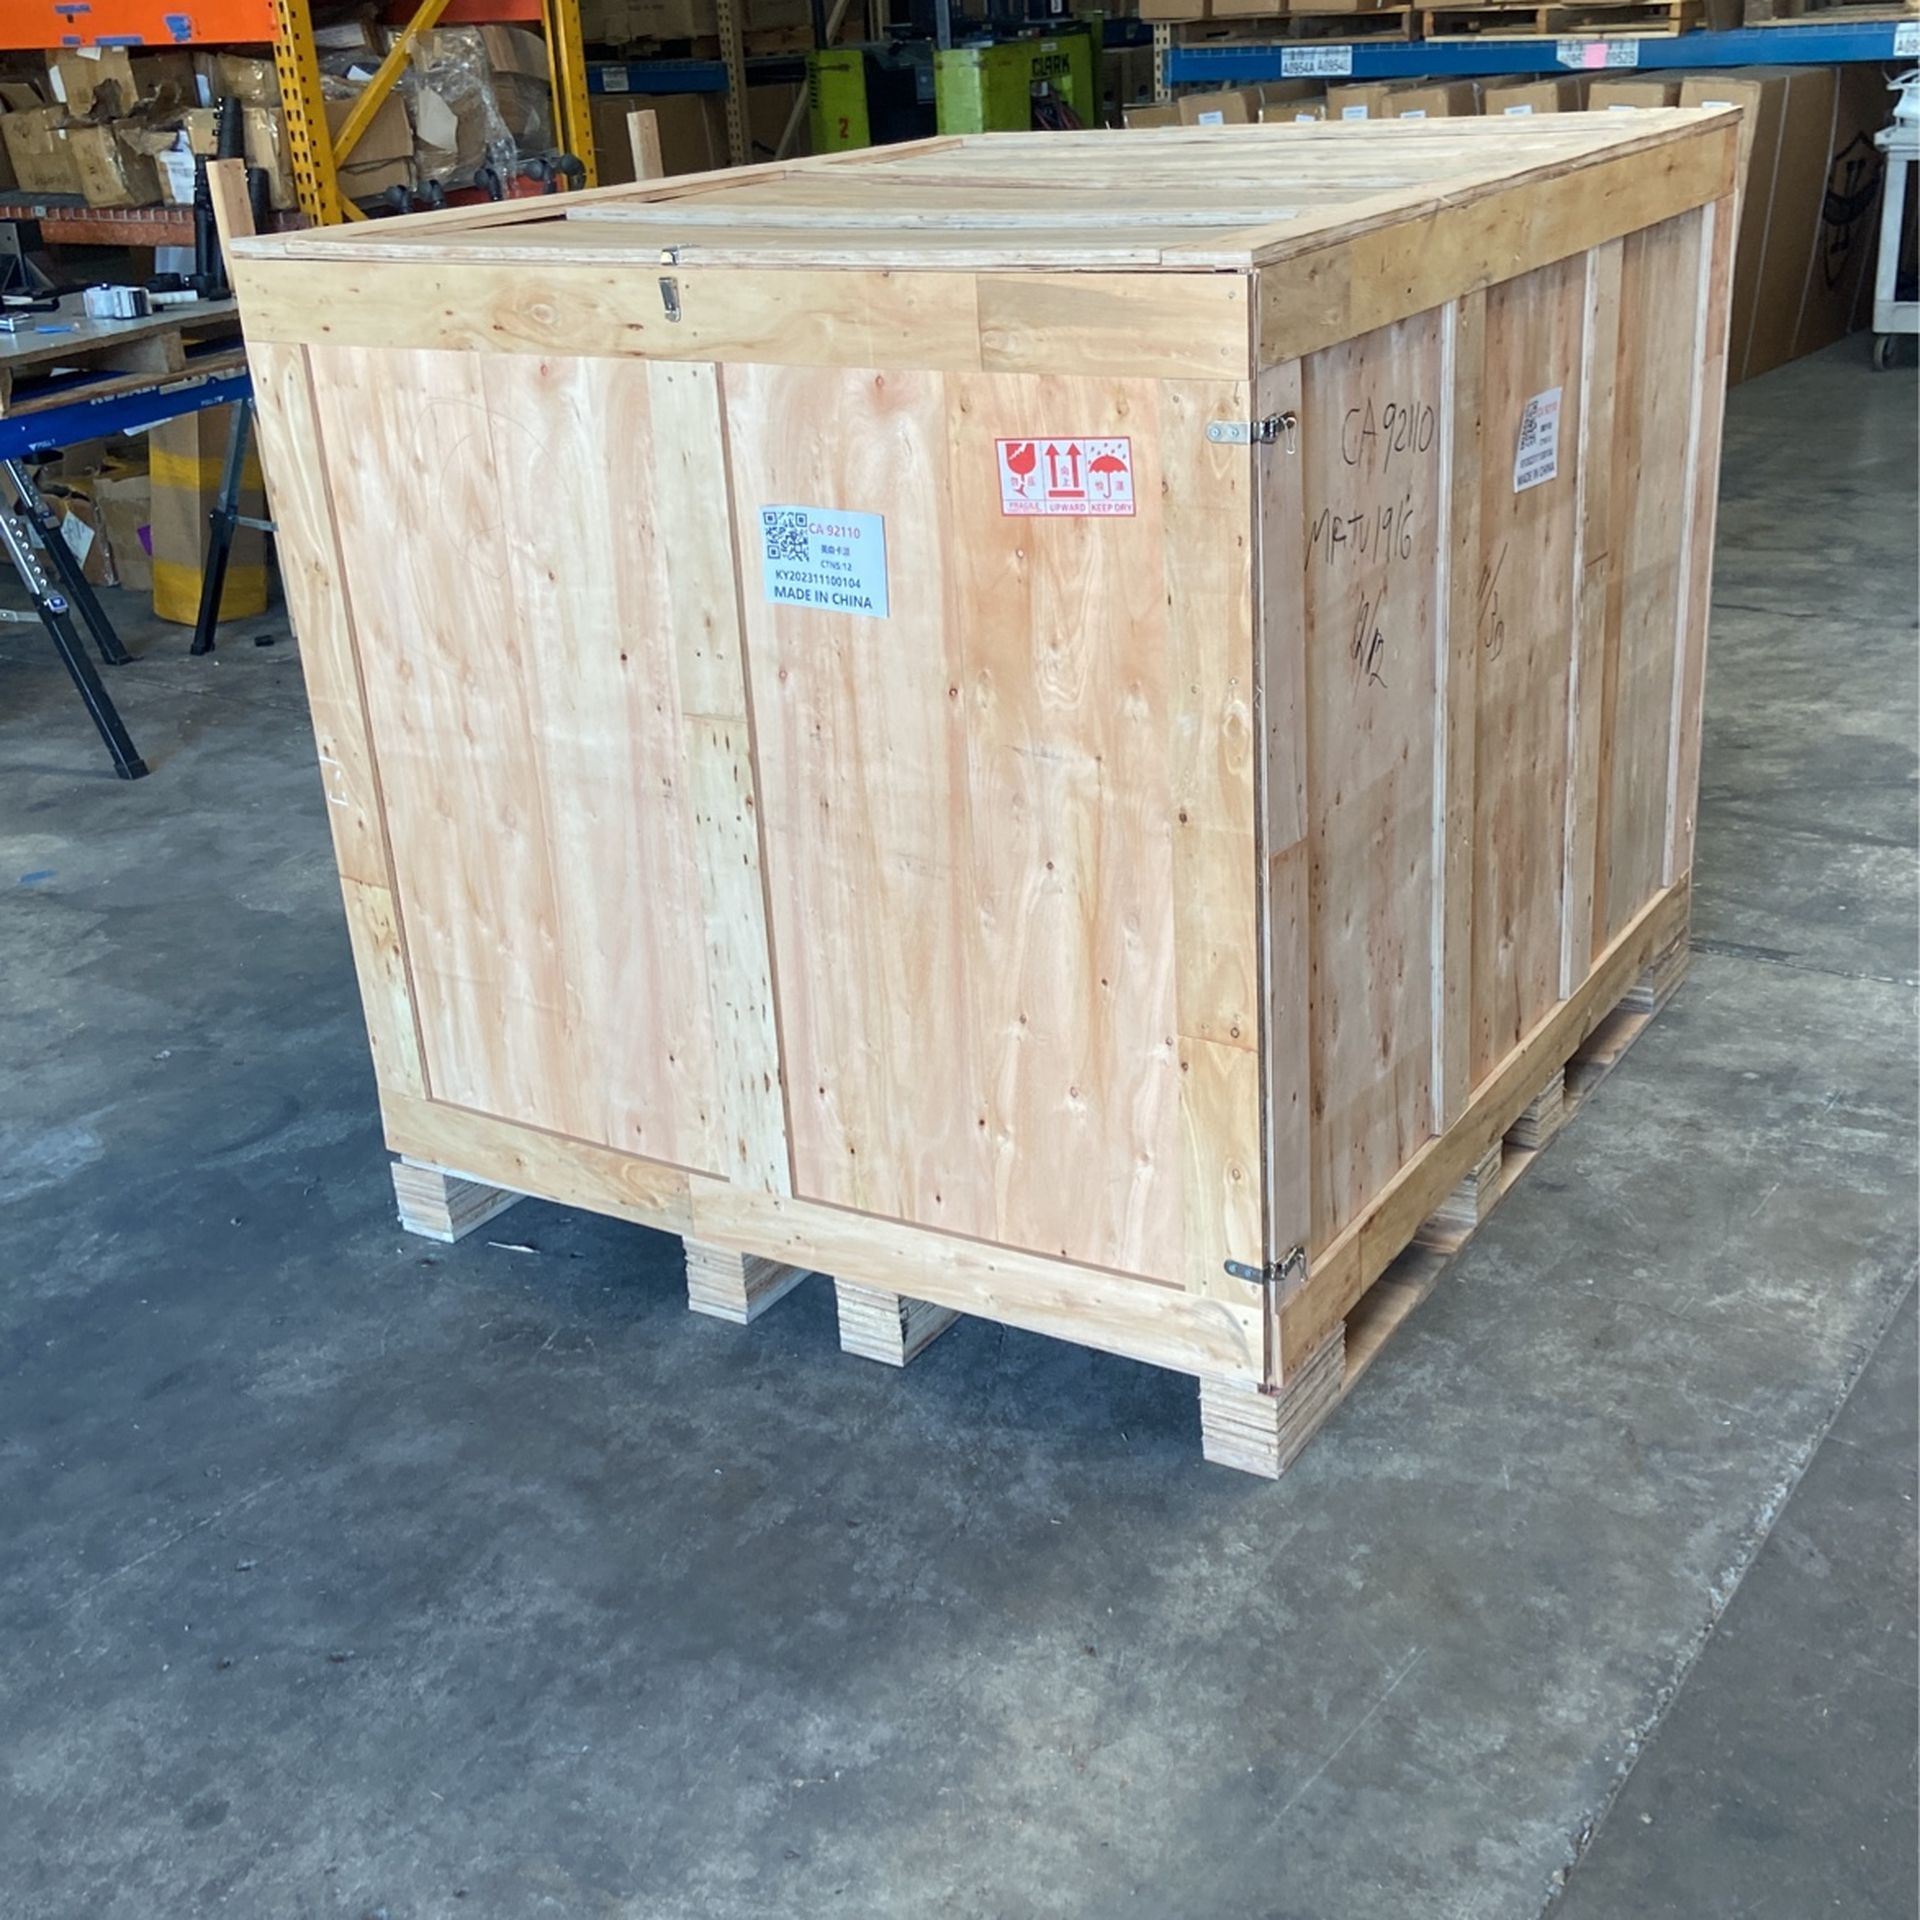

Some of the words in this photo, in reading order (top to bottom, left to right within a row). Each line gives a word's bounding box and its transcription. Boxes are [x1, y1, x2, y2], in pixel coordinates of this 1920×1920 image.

[1031, 53, 1070, 77] CLARK
[838, 117, 849, 139] 2
[1342, 397, 1378, 468] CA
[1383, 401, 1435, 474] 92110
[1049, 503, 1086, 512] UPWARD
[1091, 503, 1112, 512] KEEP
[1114, 503, 1132, 512] DRY
[808, 523, 824, 535] CA
[826, 525, 861, 539] 92110
[775, 570, 861, 589] KY202311100104
[774, 586, 812, 601] MADE
[815, 590, 829, 604] IN
[832, 593, 873, 609] CHINA
